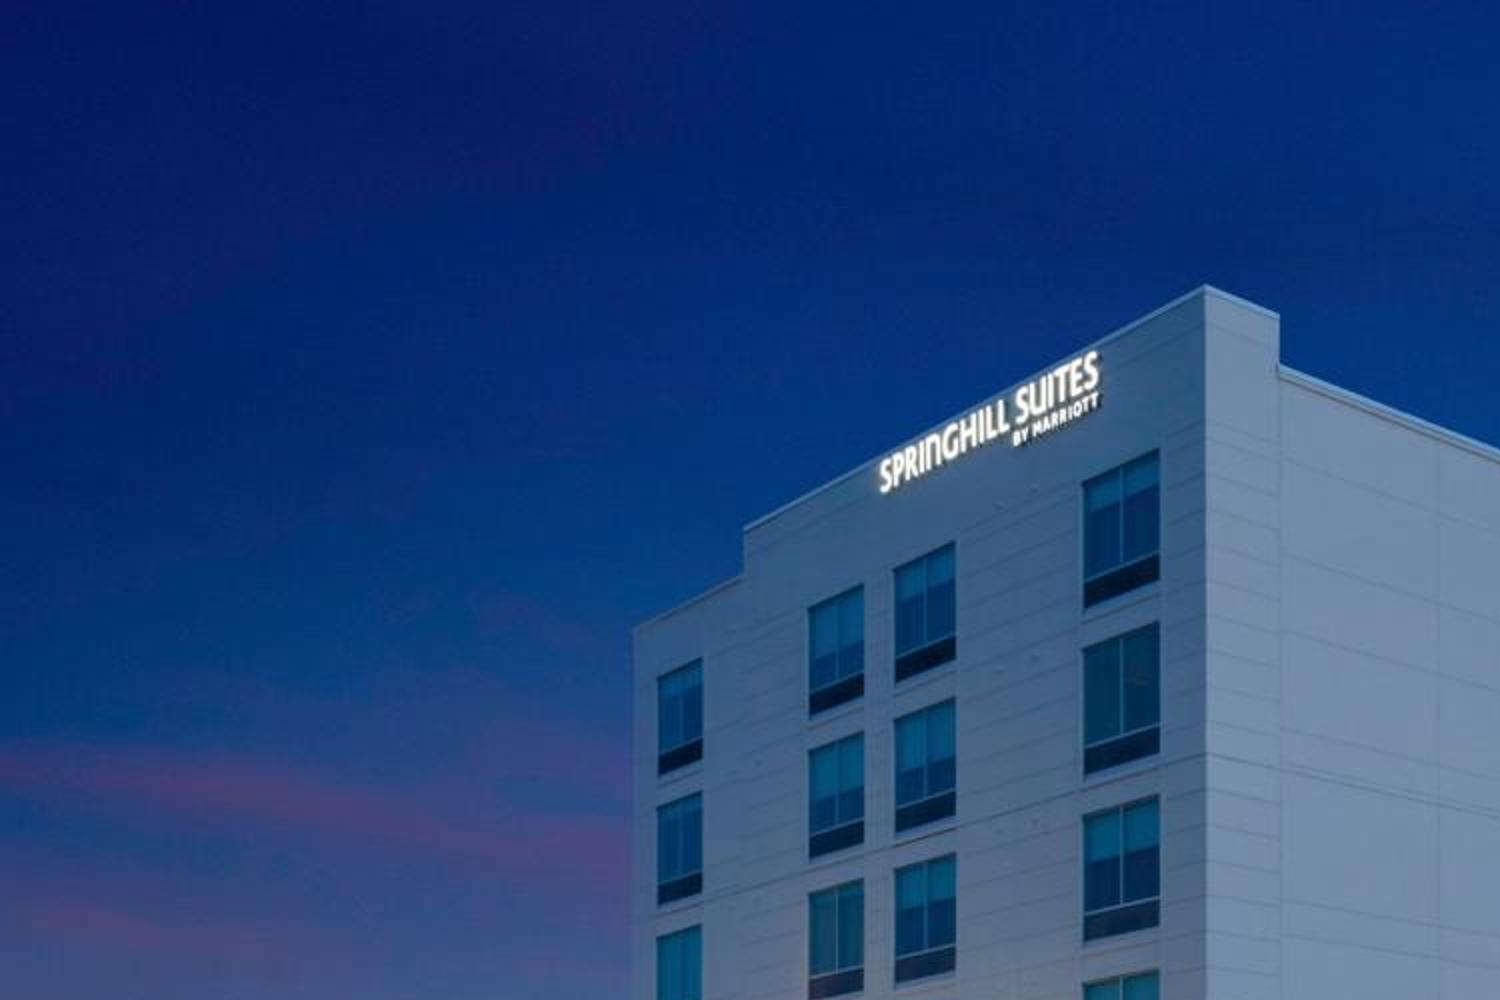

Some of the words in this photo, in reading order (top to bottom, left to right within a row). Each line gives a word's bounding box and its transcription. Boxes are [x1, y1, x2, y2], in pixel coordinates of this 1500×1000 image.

[880, 399, 1010, 494] SPRINGHILL
[1015, 351, 1099, 424] SUITES
[1012, 427, 1029, 447] BY
[1032, 391, 1099, 437] MARRIOTT
